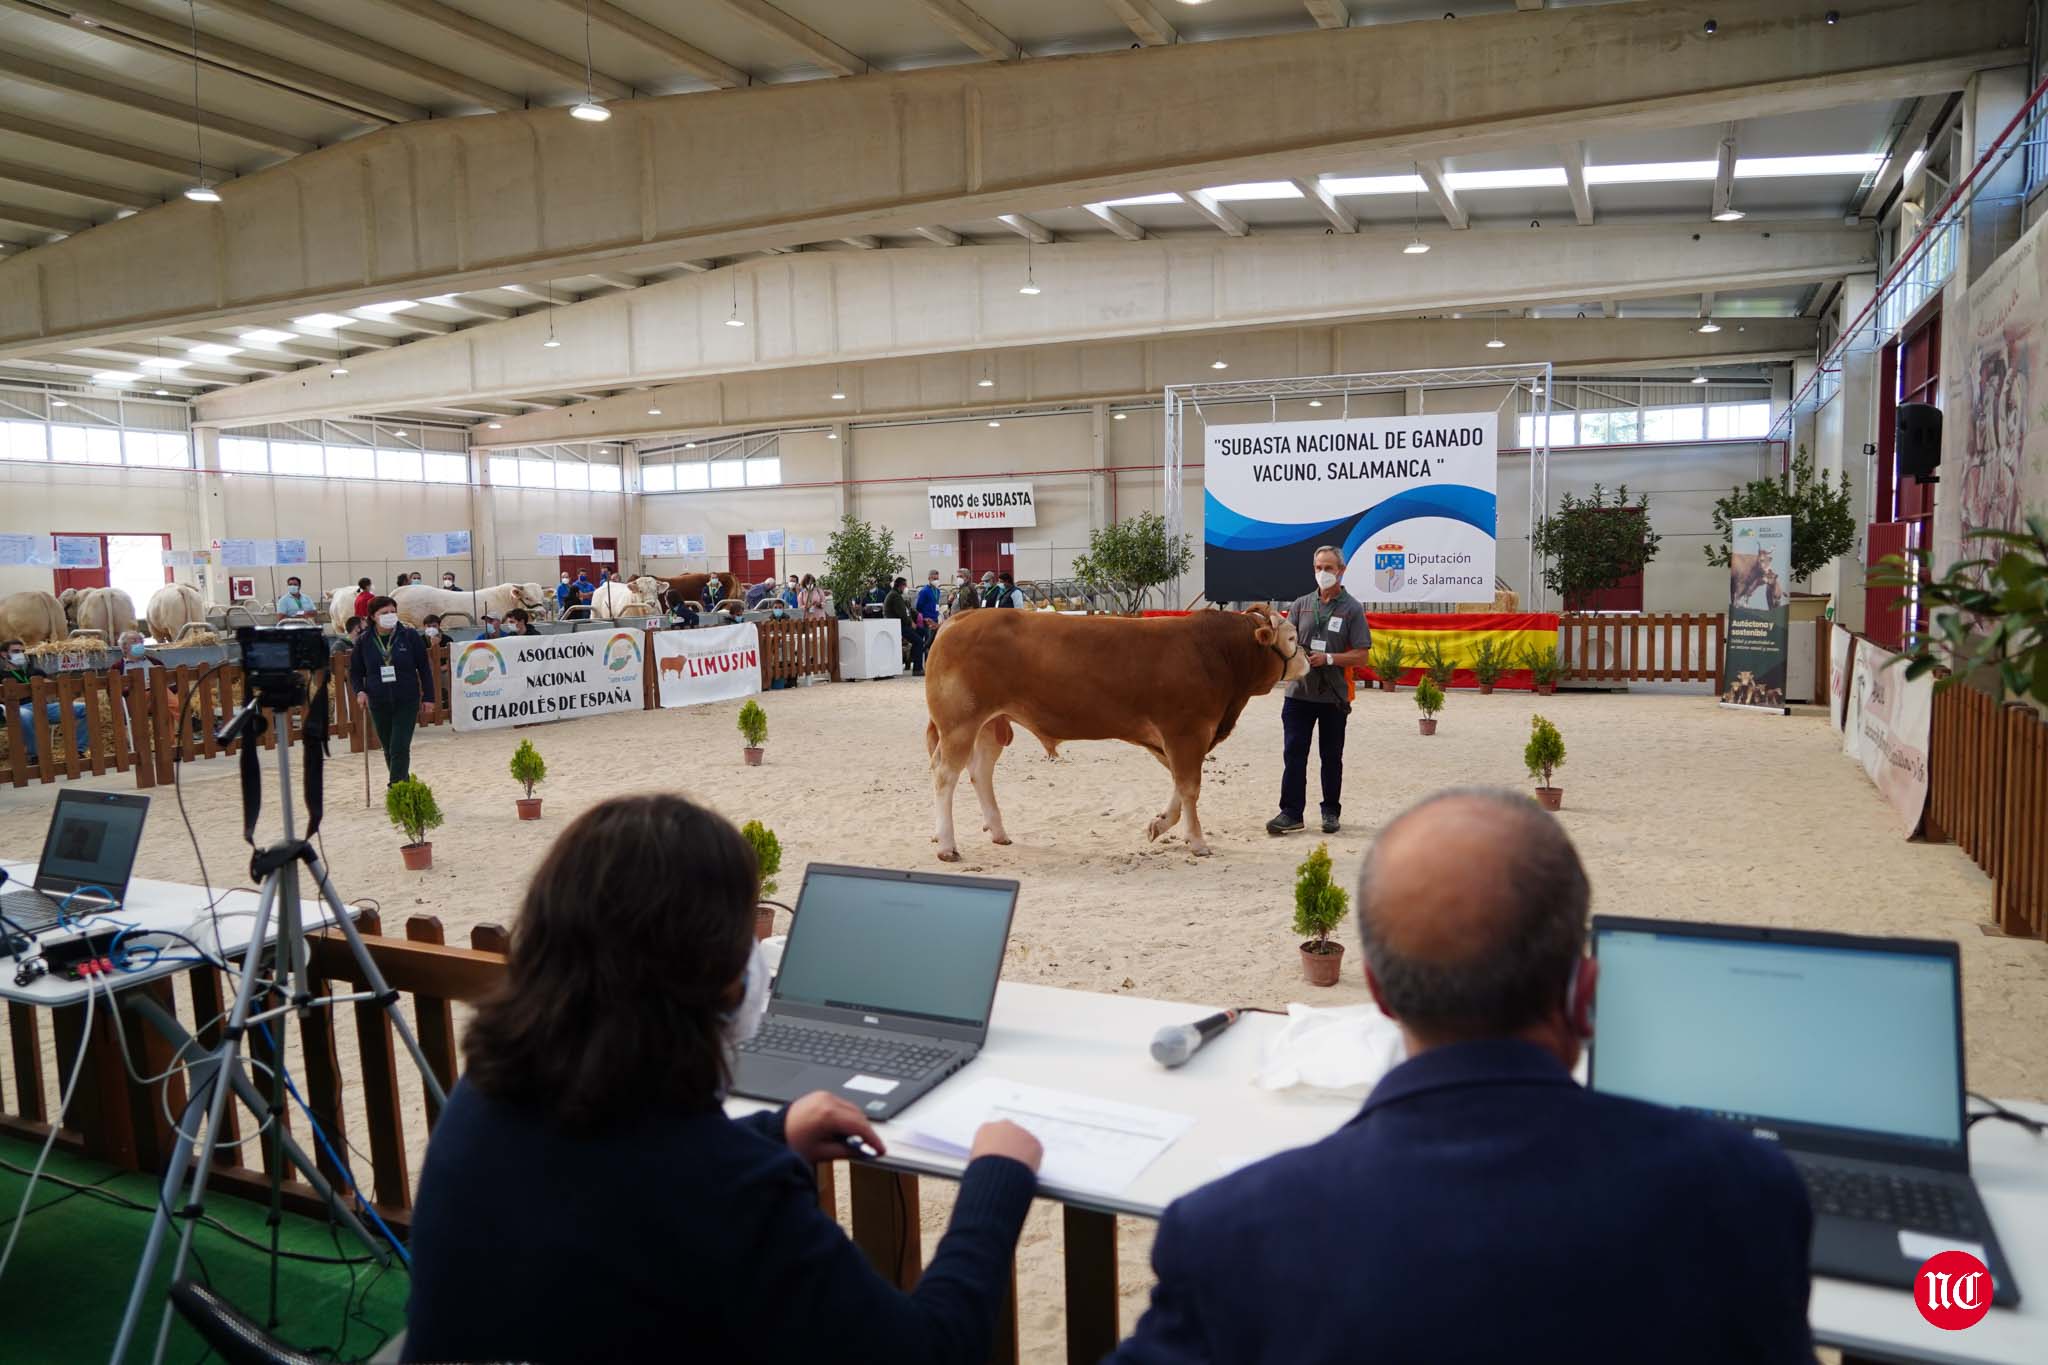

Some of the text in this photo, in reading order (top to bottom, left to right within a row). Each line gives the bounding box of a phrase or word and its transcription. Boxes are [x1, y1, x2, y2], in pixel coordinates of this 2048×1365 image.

[1214, 428, 1483, 456] "SUBASTA NACIONAL DE GANADO
[1253, 464, 1321, 482] VACUNO,
[1328, 459, 1431, 480] SALAMANCA
[930, 492, 1032, 508] TOROS de SUBASTA
[969, 511, 1006, 519] LIMUSIN
[1408, 552, 1471, 566] Diputación
[1408, 574, 1483, 585] de Salamanca
[1731, 629, 1768, 637] sostenible
[1732, 619, 1775, 631] Autóctona y
[517, 642, 594, 663] ASOCIACIÓN
[688, 650, 757, 677] LIMUSIN
[526, 671, 587, 688] NACIONAL
[472, 686, 632, 721] CHAROLÉS DE ESPAÑA
